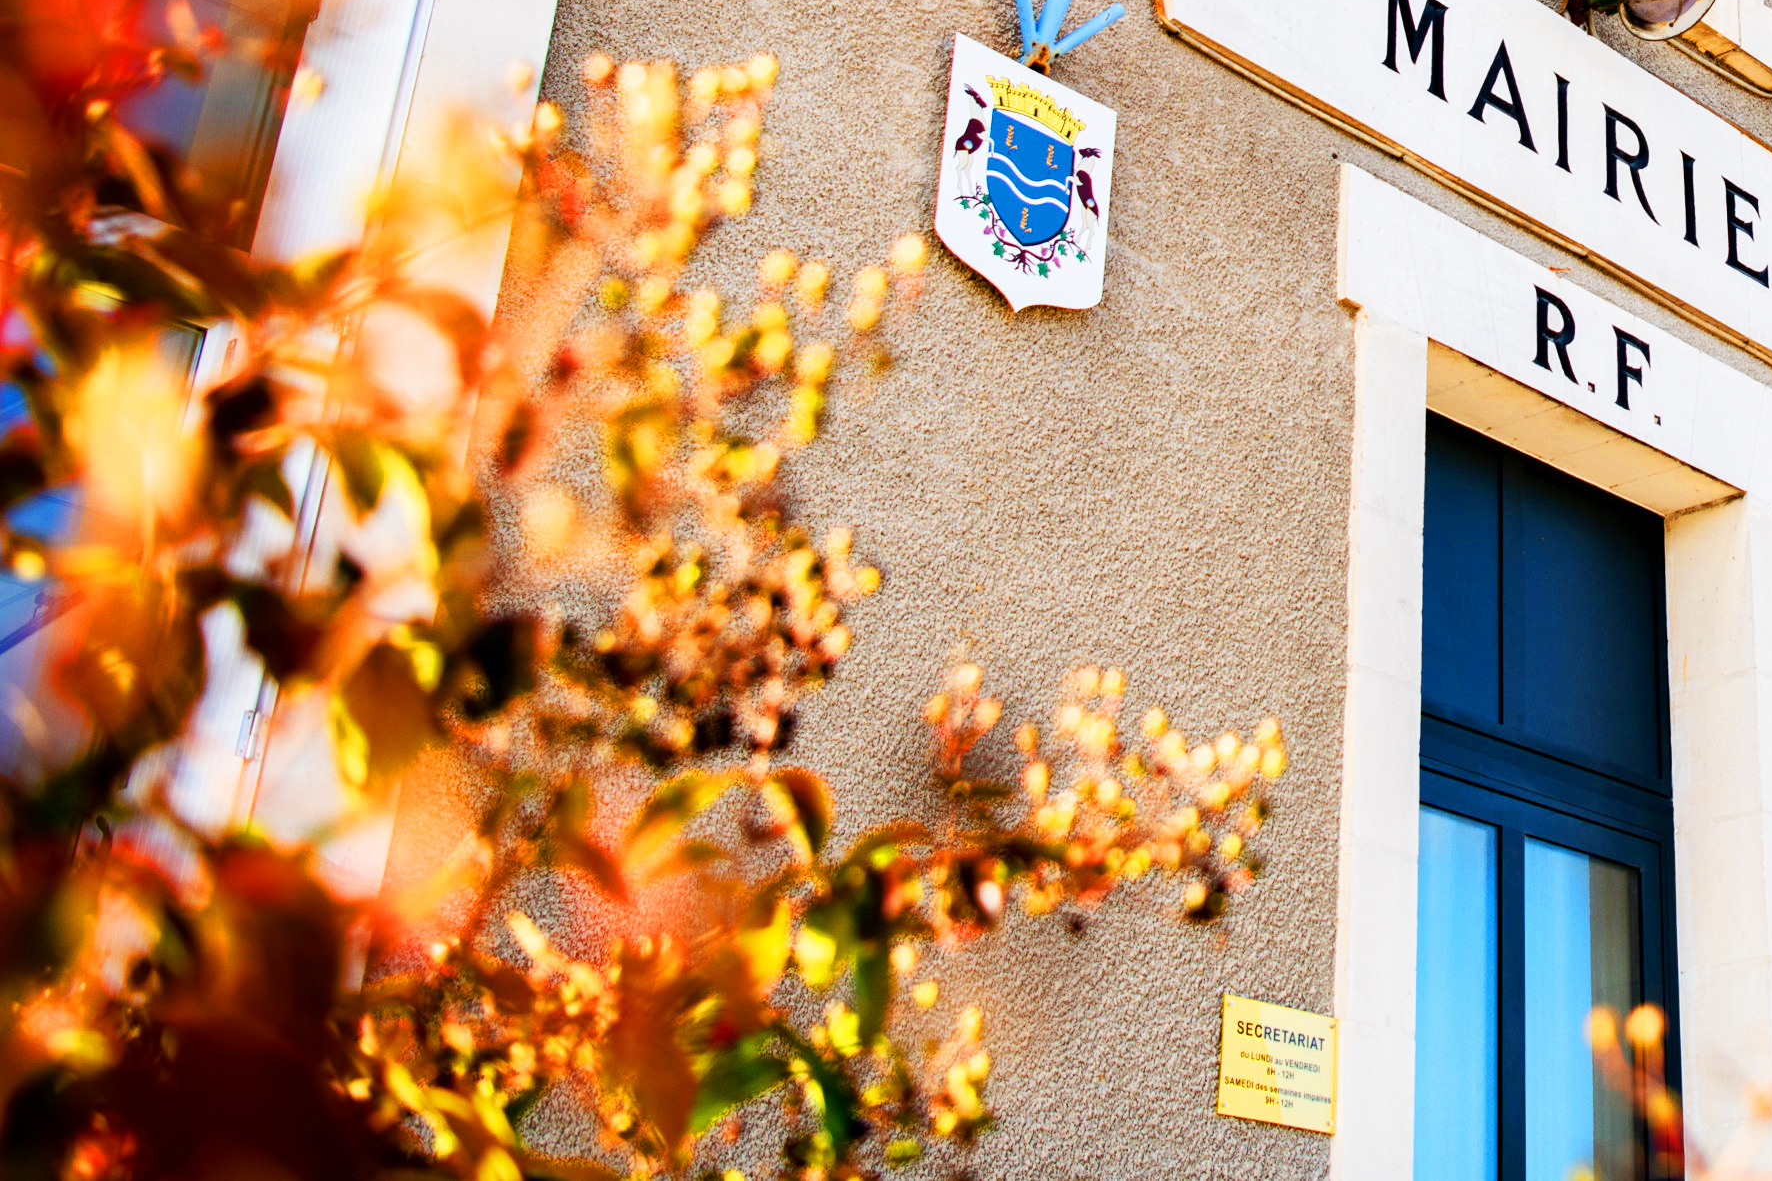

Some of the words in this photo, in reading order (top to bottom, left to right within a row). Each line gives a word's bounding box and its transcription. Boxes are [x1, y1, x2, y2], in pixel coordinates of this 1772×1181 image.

[1236, 1020, 1325, 1051] SECRETARIAT
[1240, 1050, 1249, 1059] du
[1251, 1051, 1273, 1064] LUNDI
[1274, 1058, 1283, 1066] au
[1284, 1058, 1320, 1073] VENDREDI
[1282, 1070, 1295, 1080] 12H
[1224, 1075, 1254, 1089] SAMEDI
[1255, 1082, 1268, 1092] des
[1269, 1086, 1302, 1099] semaines
[1303, 1091, 1332, 1105] impaires
[1265, 1095, 1275, 1105] 9H
[1281, 1099, 1293, 1109] 12H
